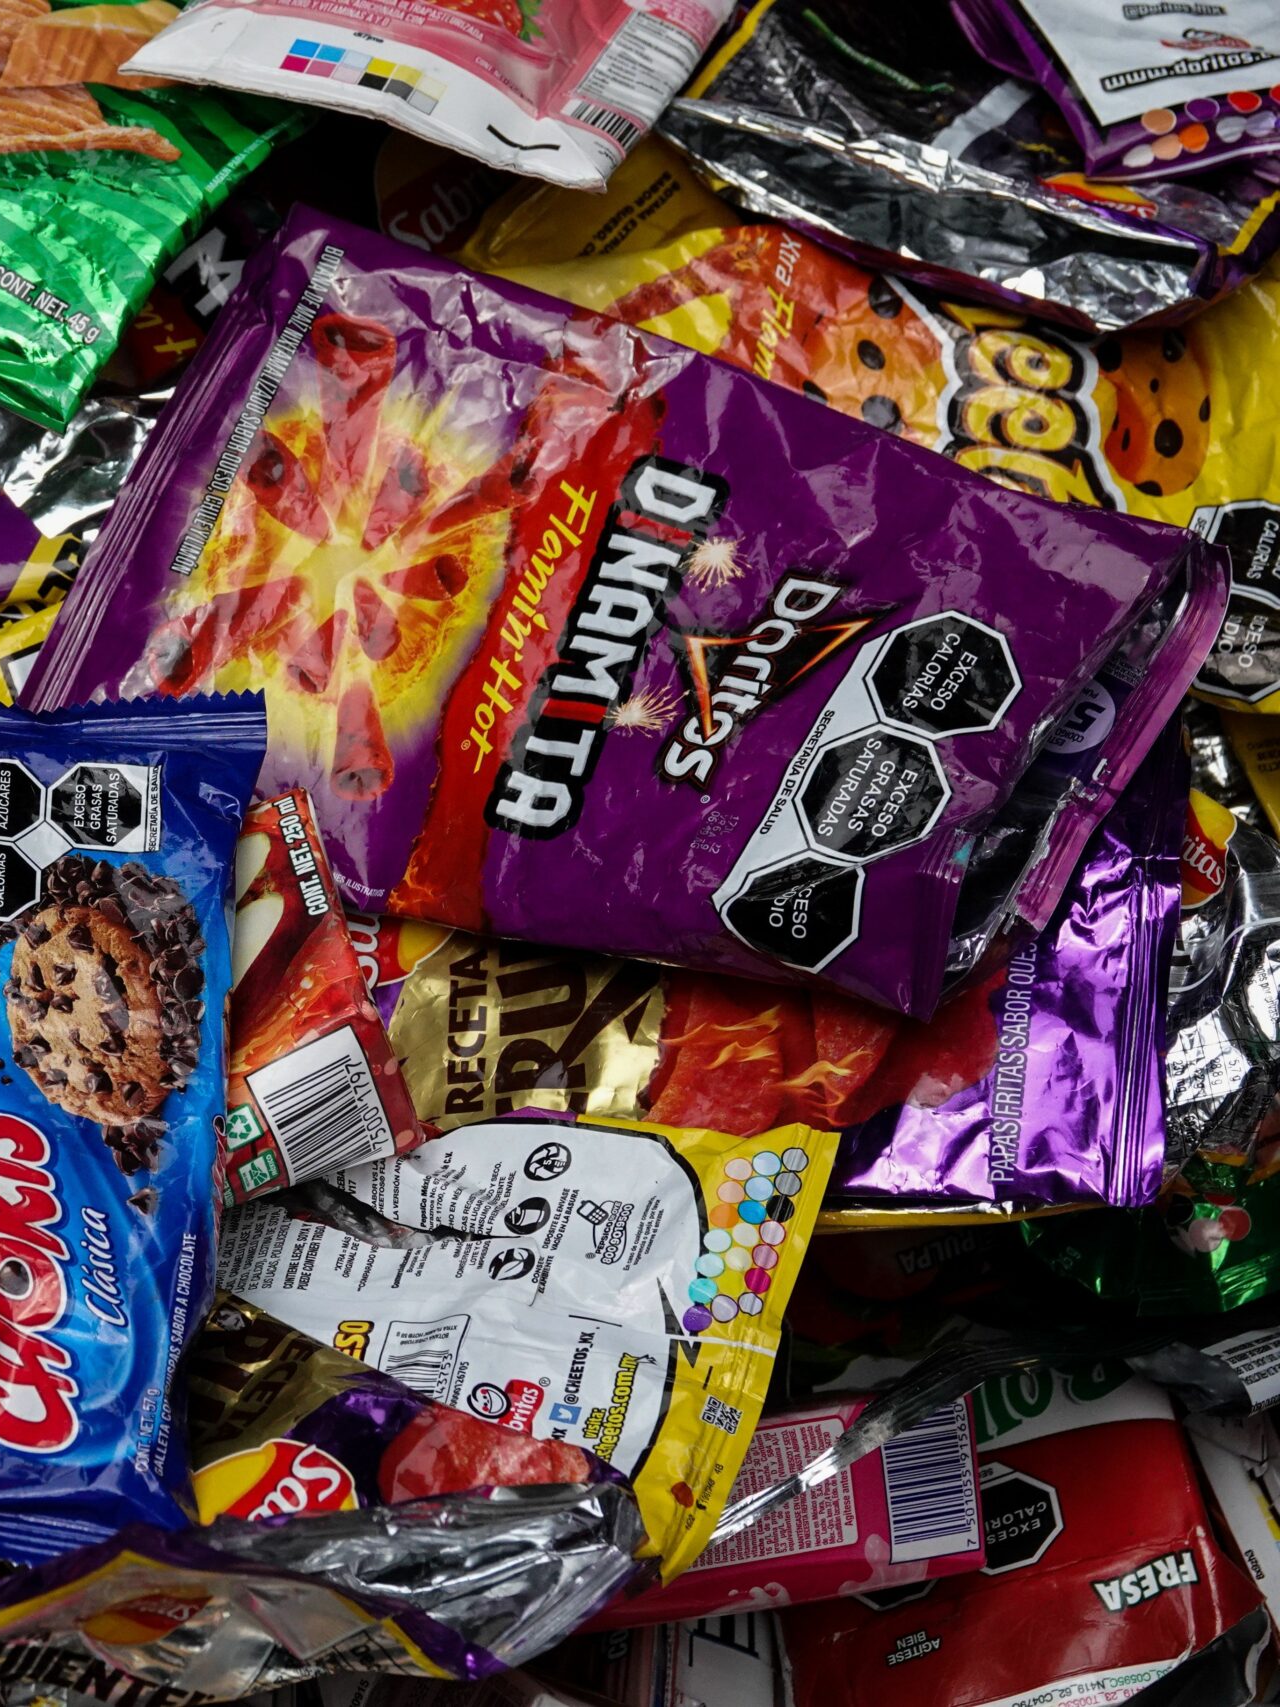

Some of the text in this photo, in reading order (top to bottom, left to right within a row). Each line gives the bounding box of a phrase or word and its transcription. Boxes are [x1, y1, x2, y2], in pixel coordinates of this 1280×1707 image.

[769, 232, 803, 287] Xtra
[34, 291, 68, 322] NET.
[67, 312, 90, 332] 45
[170, 243, 343, 576] BOTANA DE MAÍZ NIXTAMALIZADO SABOR QUESO, CHILE LIMÓN
[1247, 521, 1280, 580] CALORÍAS
[495, 465, 716, 828] DINAMITA
[903, 632, 960, 709] CALORÍAS
[664, 578, 841, 783] Doritos
[930, 651, 978, 711] EXCESO
[470, 656, 522, 774] Hot
[151, 795, 159, 807] DE
[759, 709, 835, 835] SECRETARÍA DE SALUD
[817, 737, 882, 837] SATURADAS
[847, 760, 896, 832] GRASAS
[73, 784, 87, 828] EXCESO
[90, 783, 103, 830] GRASAS
[106, 772, 120, 843] SATURADAS
[148, 808, 159, 852] SECRETARÍA
[871, 768, 918, 837] EXCESO
[273, 795, 328, 917] CONT. NET. 250 ml
[445, 949, 488, 1115] RECETA
[990, 989, 1032, 1182] PAPAS FRITAS SABOR
[416, 1199, 431, 1227] PepsiCo
[542, 1187, 570, 1249] DEPOSITE ENVASE
[565, 1188, 579, 1215] BASURA
[81, 1205, 127, 1327] Clásica
[297, 1240, 320, 1290] PUEDE CONTENER
[594, 1220, 613, 1255] PEPSICO
[153, 1232, 197, 1475] GALLETA SABOR CHOCOLATE
[561, 1329, 595, 1406] @CHEETOS_MX
[581, 1405, 605, 1440] visita:
[839, 1470, 849, 1493] antes
[961, 1468, 976, 1527] 501055
[986, 1517, 1042, 1546] EXCES
[1094, 1550, 1198, 1611] FRESA
[888, 1637, 941, 1666] AGÍTESE
[896, 1630, 928, 1649] BIEN
